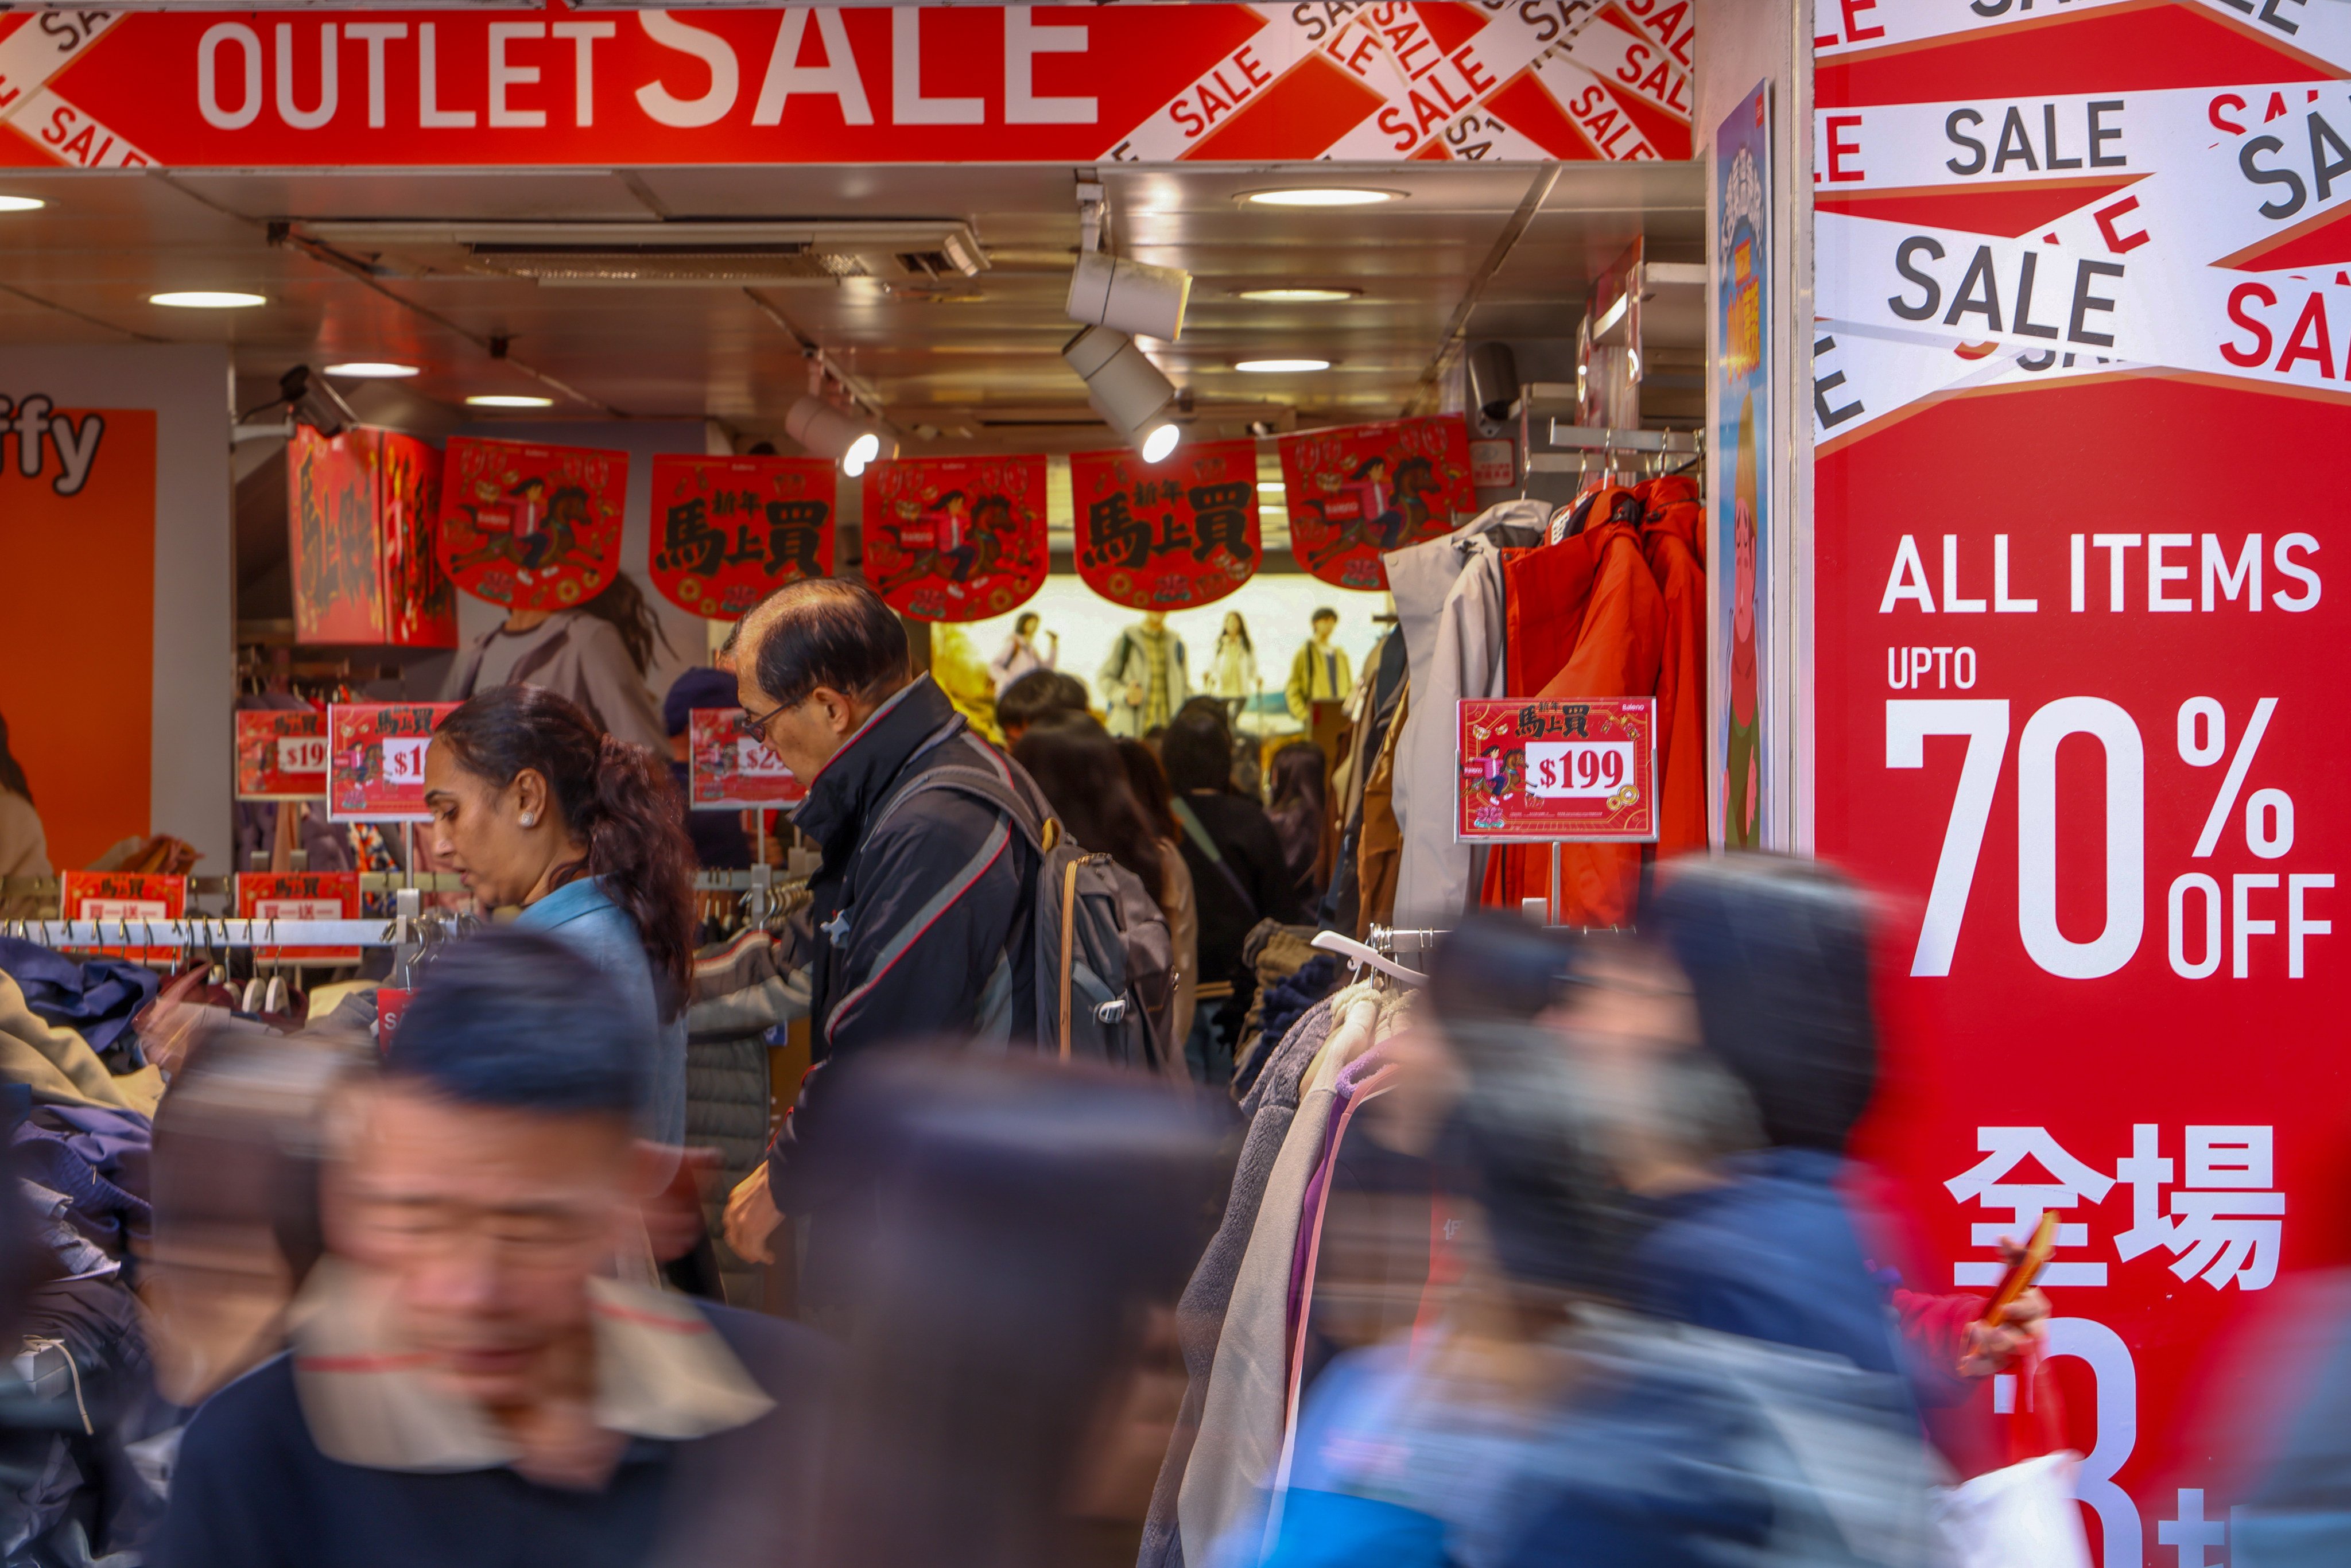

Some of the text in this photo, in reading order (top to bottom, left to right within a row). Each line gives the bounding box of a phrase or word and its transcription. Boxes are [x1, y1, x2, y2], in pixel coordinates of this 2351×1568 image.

[197, 7, 1098, 130] OUTLET SALE
[1169, 44, 1273, 139] SALE
[1377, 45, 1497, 152] SALE
[1616, 44, 1692, 115] SAL
[1946, 100, 2127, 176] SALE
[1888, 236, 2125, 348] SALE
[655, 496, 829, 578] 馬上買
[1081, 481, 1254, 570] 馬上買
[1879, 532, 2323, 614] ALL ITEMS
[1887, 646, 1977, 690] UPTO
[1514, 704, 1591, 739] 馬上買
[1539, 749, 1624, 789] $199
[2167, 872, 2335, 980] OFF
[1943, 1123, 2286, 1291] 全場
